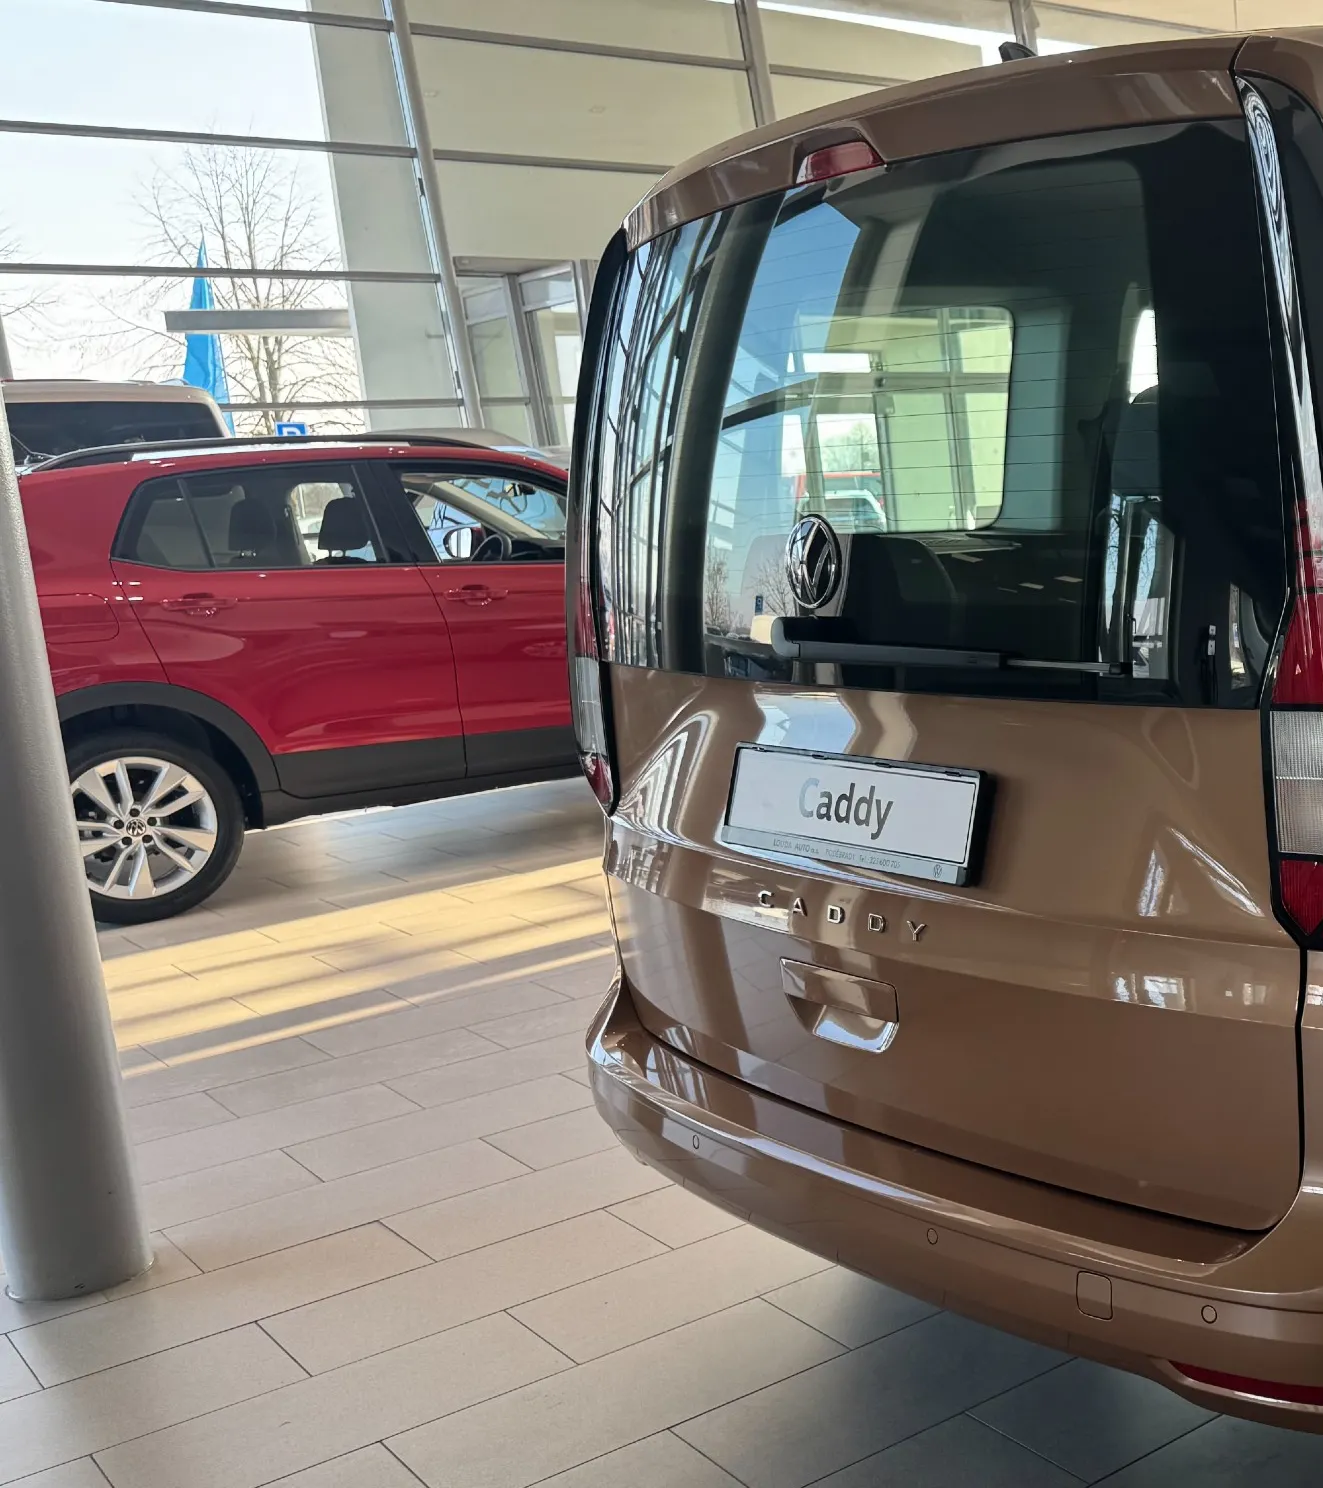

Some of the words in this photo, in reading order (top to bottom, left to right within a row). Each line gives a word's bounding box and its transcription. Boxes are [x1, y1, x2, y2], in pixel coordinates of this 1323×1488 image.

[799, 777, 894, 840] Caddy
[794, 842, 811, 853] AUTO
[758, 890, 927, 941] CADDY
